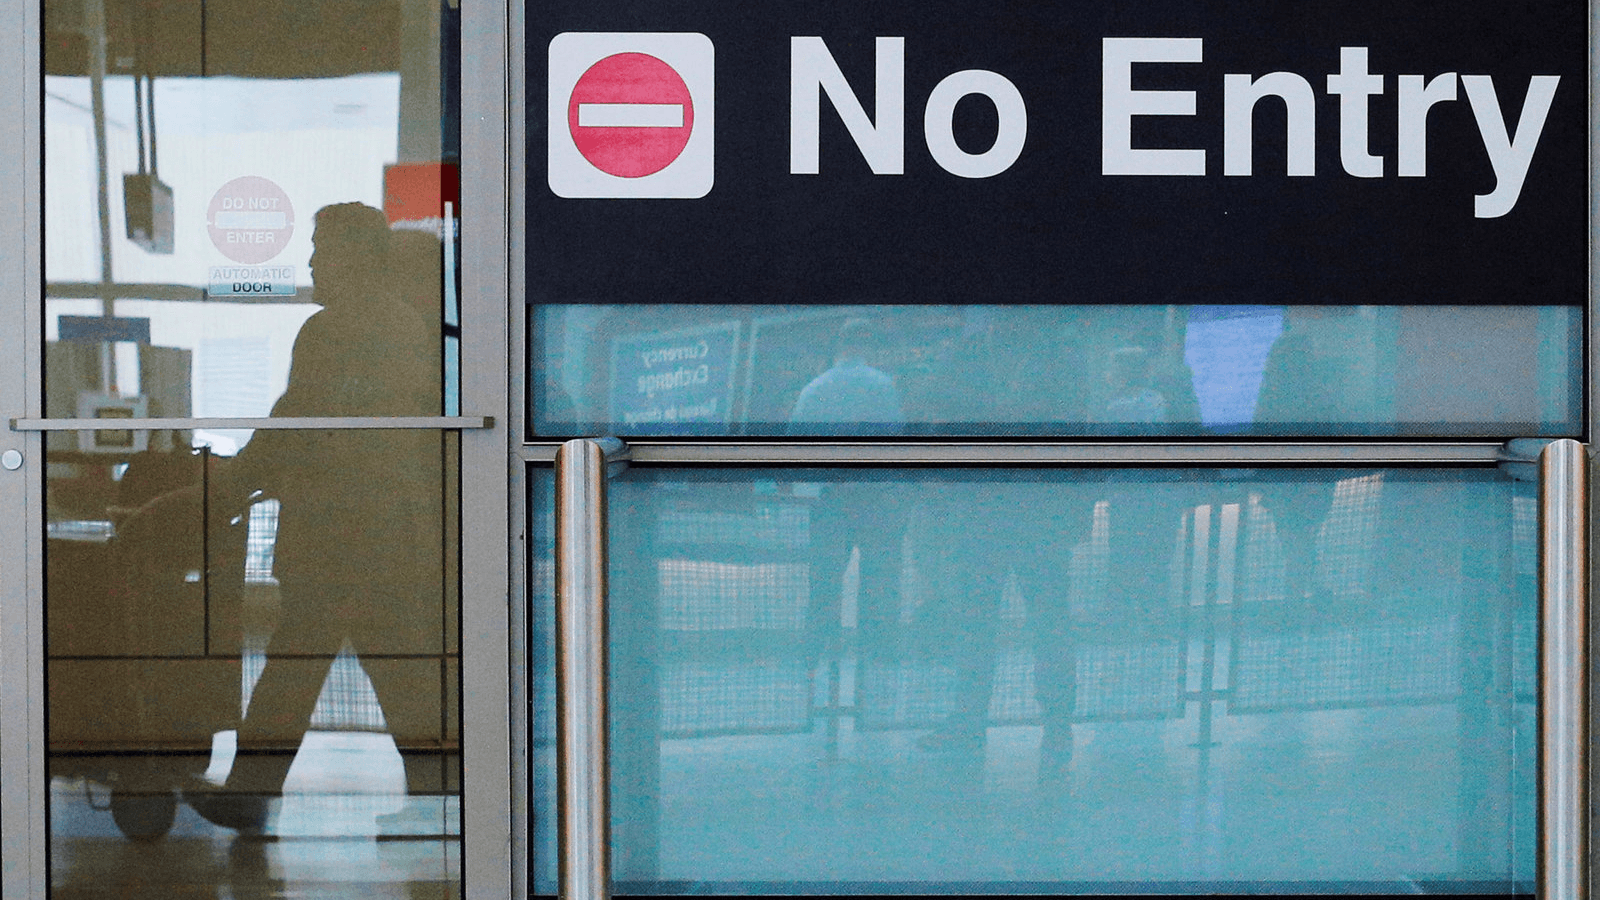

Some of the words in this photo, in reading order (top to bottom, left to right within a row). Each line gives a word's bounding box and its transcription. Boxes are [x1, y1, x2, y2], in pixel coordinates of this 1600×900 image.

[790, 37, 1027, 179] No
[1102, 37, 1560, 219] Entry
[223, 197, 244, 209] DO
[248, 197, 279, 209] NOT
[227, 232, 275, 243] ENTER
[213, 268, 291, 279] AUTOMATIC
[232, 282, 272, 292] DOOR
